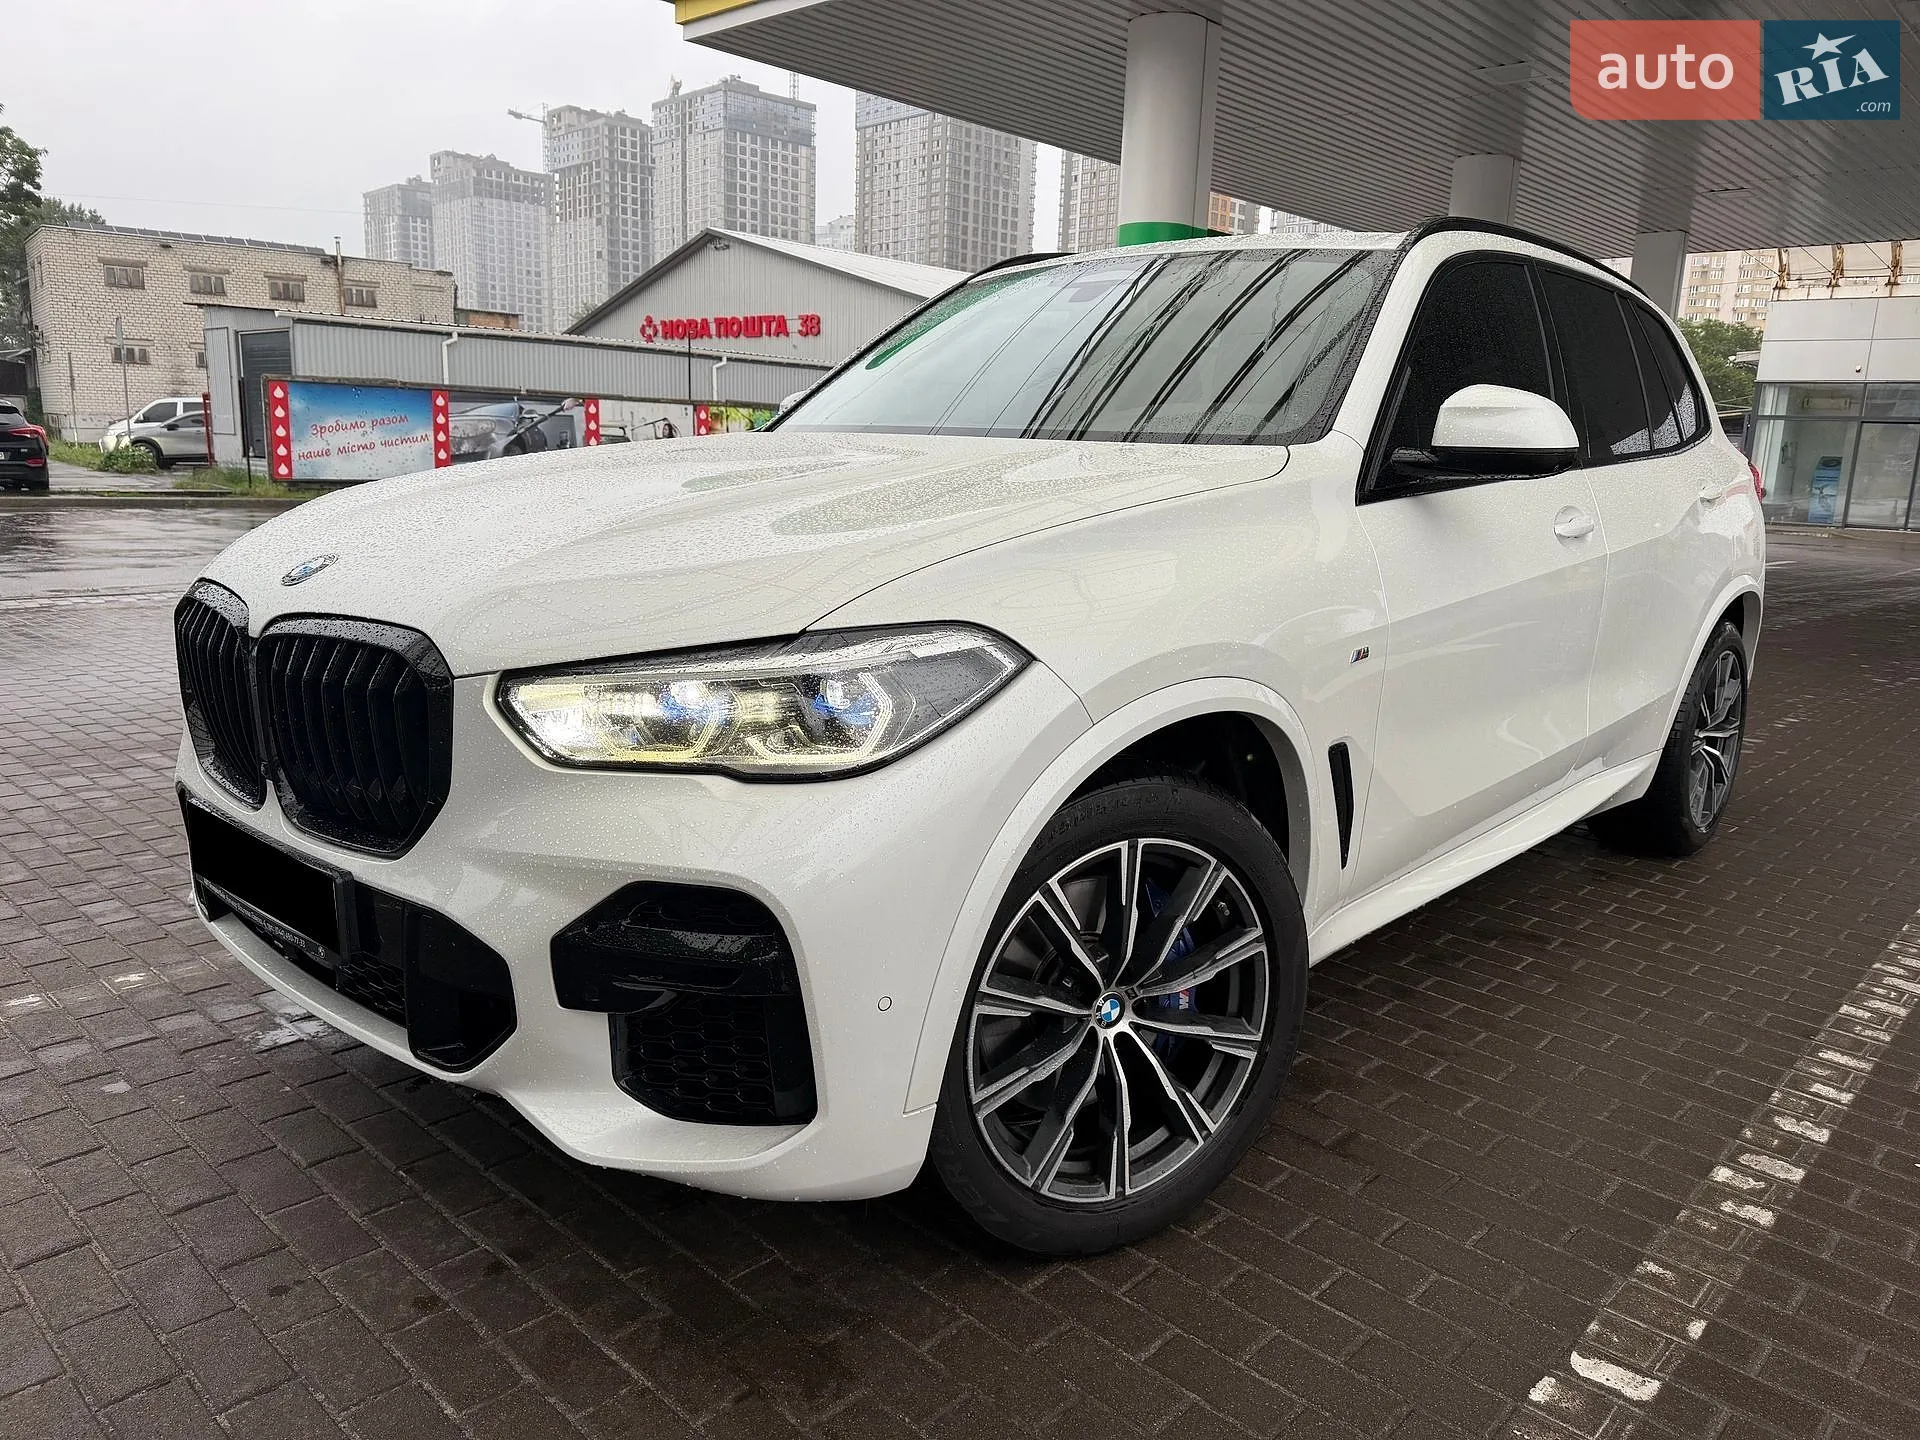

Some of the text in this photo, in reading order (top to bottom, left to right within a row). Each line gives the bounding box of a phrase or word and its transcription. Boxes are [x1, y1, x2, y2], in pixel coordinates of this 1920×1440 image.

[660, 314, 821, 340] НОВА ПОШТА 38
[310, 414, 409, 438] Зробимо разом
[297, 433, 430, 461] наше місто чистим
